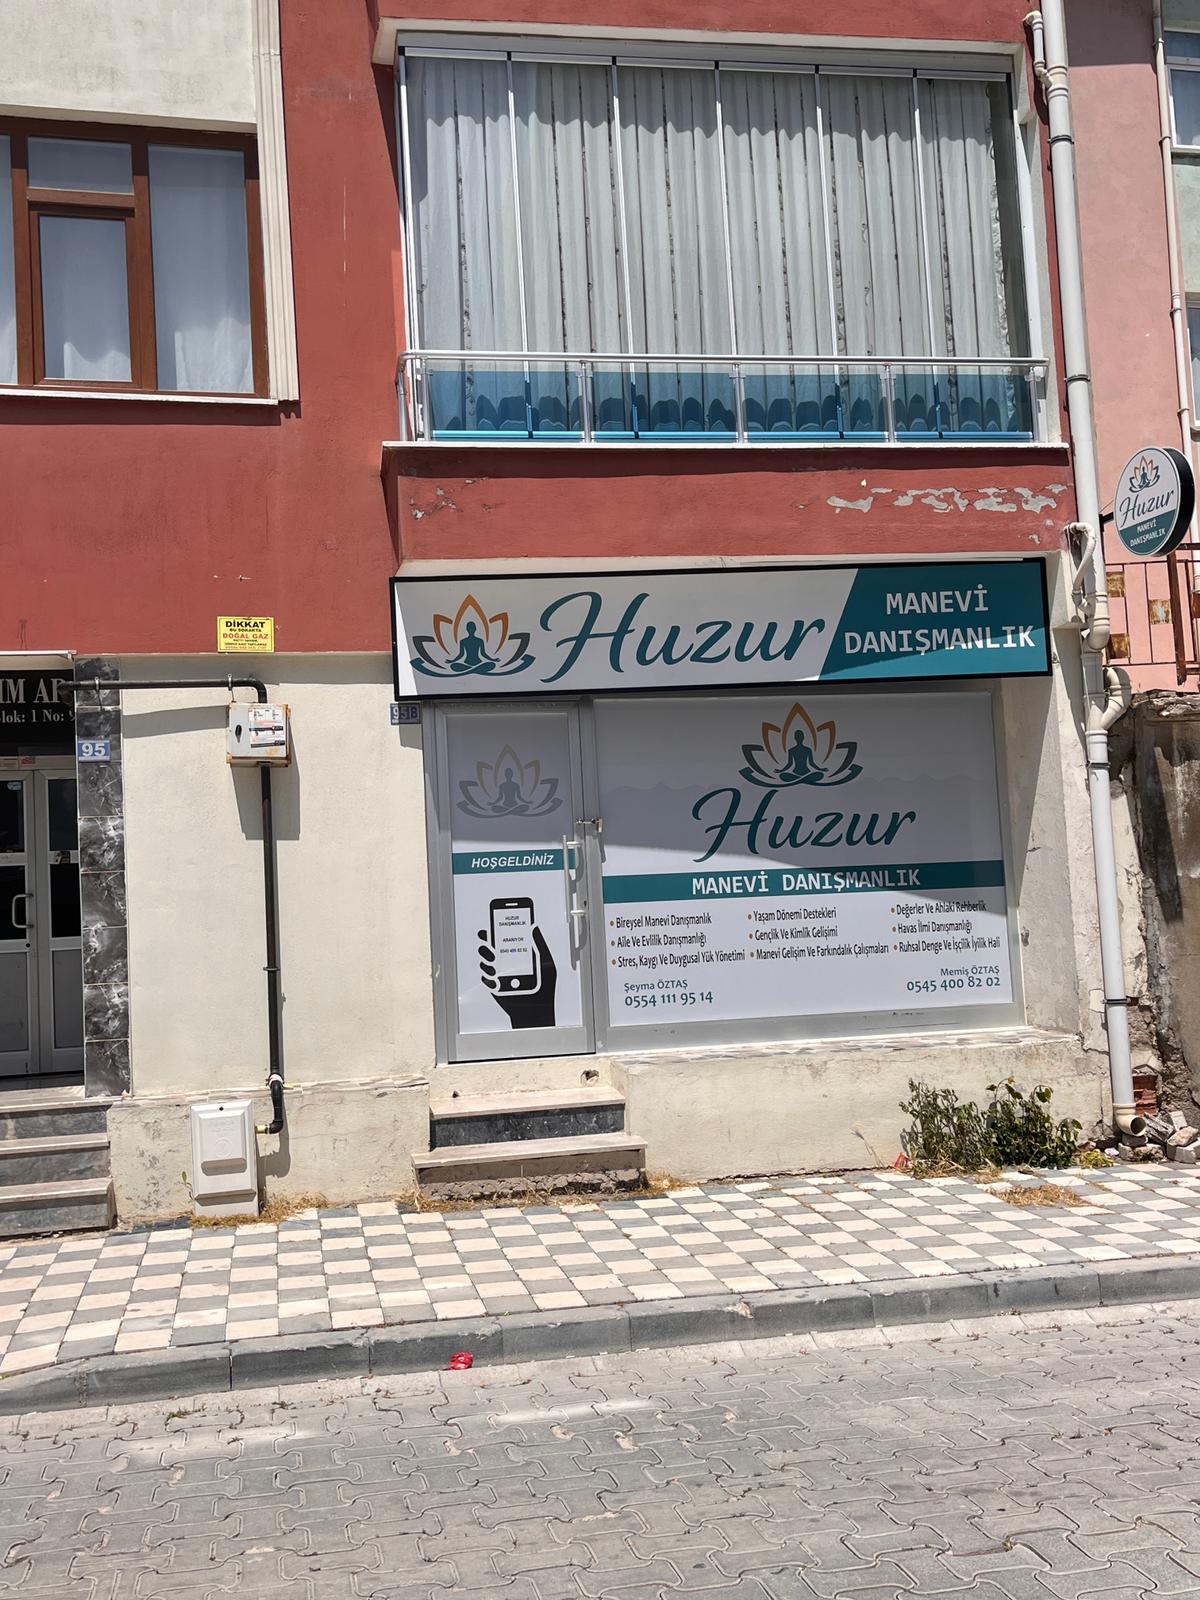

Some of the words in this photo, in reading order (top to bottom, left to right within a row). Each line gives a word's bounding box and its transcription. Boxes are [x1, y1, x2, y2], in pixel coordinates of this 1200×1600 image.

[1119, 490, 1174, 528] Huzur
[886, 584, 989, 615] MANEVİ
[226, 620, 265, 628] DİKKAT
[540, 591, 825, 683] Huzur
[845, 625, 1036, 656] DANIŞMANLIK
[0, 710, 25, 723] lok:
[43, 709, 65, 722] No:
[82, 743, 106, 757] 95
[692, 787, 916, 863] Huzur
[472, 853, 554, 869] HOŞGELDİNİZ
[692, 870, 769, 895] MANEVİ
[782, 868, 920, 893] DANIŞMANLIK
[753, 910, 776, 924] Yaşam
[776, 908, 802, 921] Dönemi
[804, 907, 837, 920] Destekleri
[896, 904, 924, 919] Değerler
[925, 904, 934, 913] Ve
[935, 901, 956, 914] Ahlaki
[956, 900, 987, 912] Rehberlik
[616, 916, 644, 931] Bireysel
[645, 915, 670, 927] Manevi
[671, 913, 712, 928] Danışmanlık
[898, 923, 917, 934] Havas
[932, 920, 972, 934] Danışmanlığı
[617, 936, 631, 948] Aile
[632, 936, 641, 947] Ve
[642, 934, 662, 946] Evlilik
[664, 932, 707, 948] Danışmanlığı
[755, 928, 780, 943] Gençlik
[780, 928, 789, 940] Ve
[790, 927, 811, 939] Kimlik
[812, 926, 838, 940] Gelişimi
[756, 948, 781, 960] Manevi
[782, 946, 806, 961] Gelişim
[807, 947, 816, 957] Ve
[817, 944, 853, 957] Farkındalık
[854, 942, 889, 958] Çalışmaları
[900, 940, 921, 953] Ruhsal
[922, 940, 943, 954] Denge
[943, 940, 952, 950] Ve
[988, 937, 1001, 948] Hali
[618, 956, 638, 969] Stres,
[640, 955, 658, 970] Kaygı
[659, 954, 668, 966] Ve
[669, 952, 700, 968] Duygusal
[701, 951, 714, 963] Yük
[714, 949, 746, 962] Yönetimi
[940, 967, 969, 977] Memiş
[971, 964, 1000, 975] ÖZTAŞ
[624, 982, 655, 994] Şeyma
[657, 979, 688, 990] ÖZTAŞ
[907, 980, 937, 993] 0545
[940, 979, 964, 991] 400
[968, 976, 983, 988] 82
[986, 977, 1001, 987] 02
[624, 994, 657, 1008] 0554
[660, 994, 676, 1004] 111
[680, 992, 697, 1006] 95
[700, 991, 713, 1004] 14
